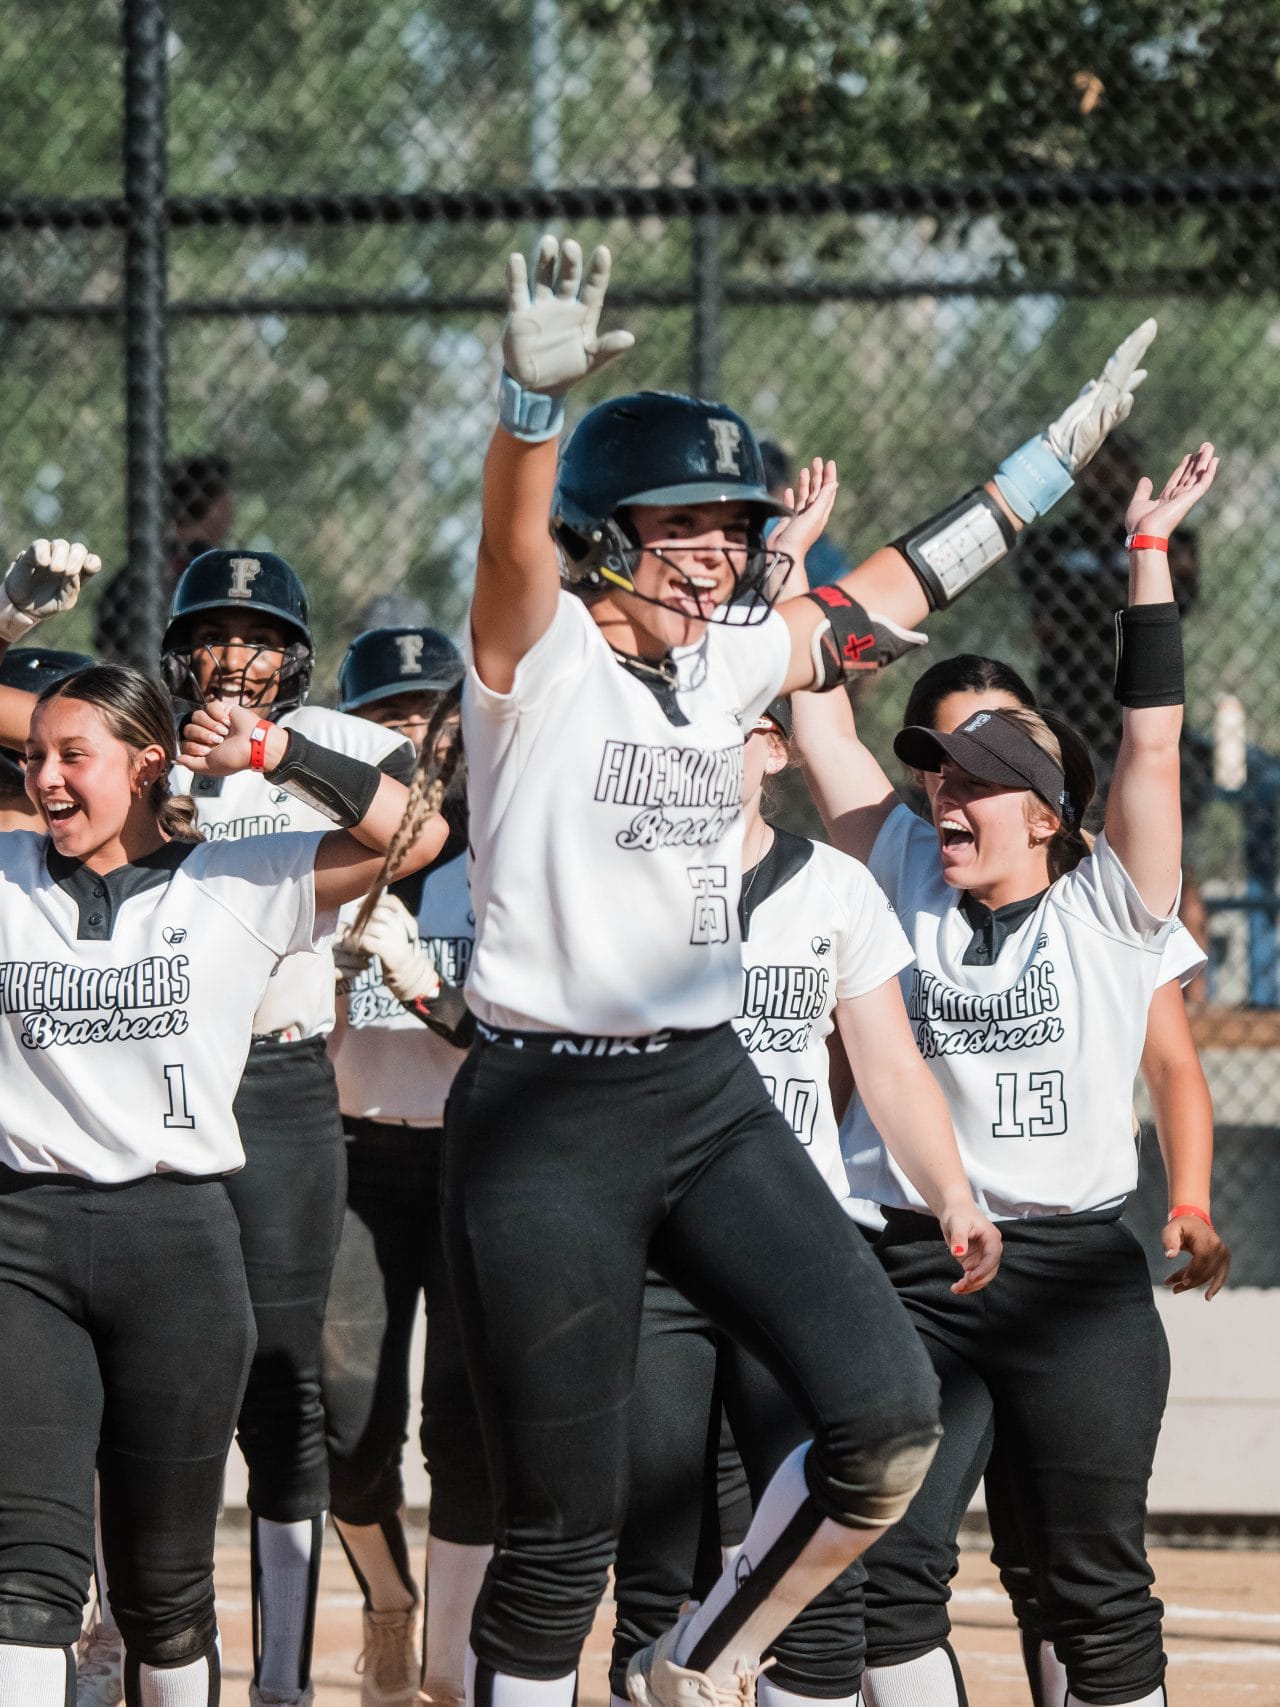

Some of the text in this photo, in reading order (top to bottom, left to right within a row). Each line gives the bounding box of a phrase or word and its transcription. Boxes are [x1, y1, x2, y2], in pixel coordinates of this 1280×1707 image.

[707, 417, 741, 476] F
[229, 557, 261, 598] F
[395, 634, 424, 674] F
[21, 1008, 189, 1050] Brashear
[163, 1063, 196, 1129] 1
[992, 1069, 1068, 1138] 13
